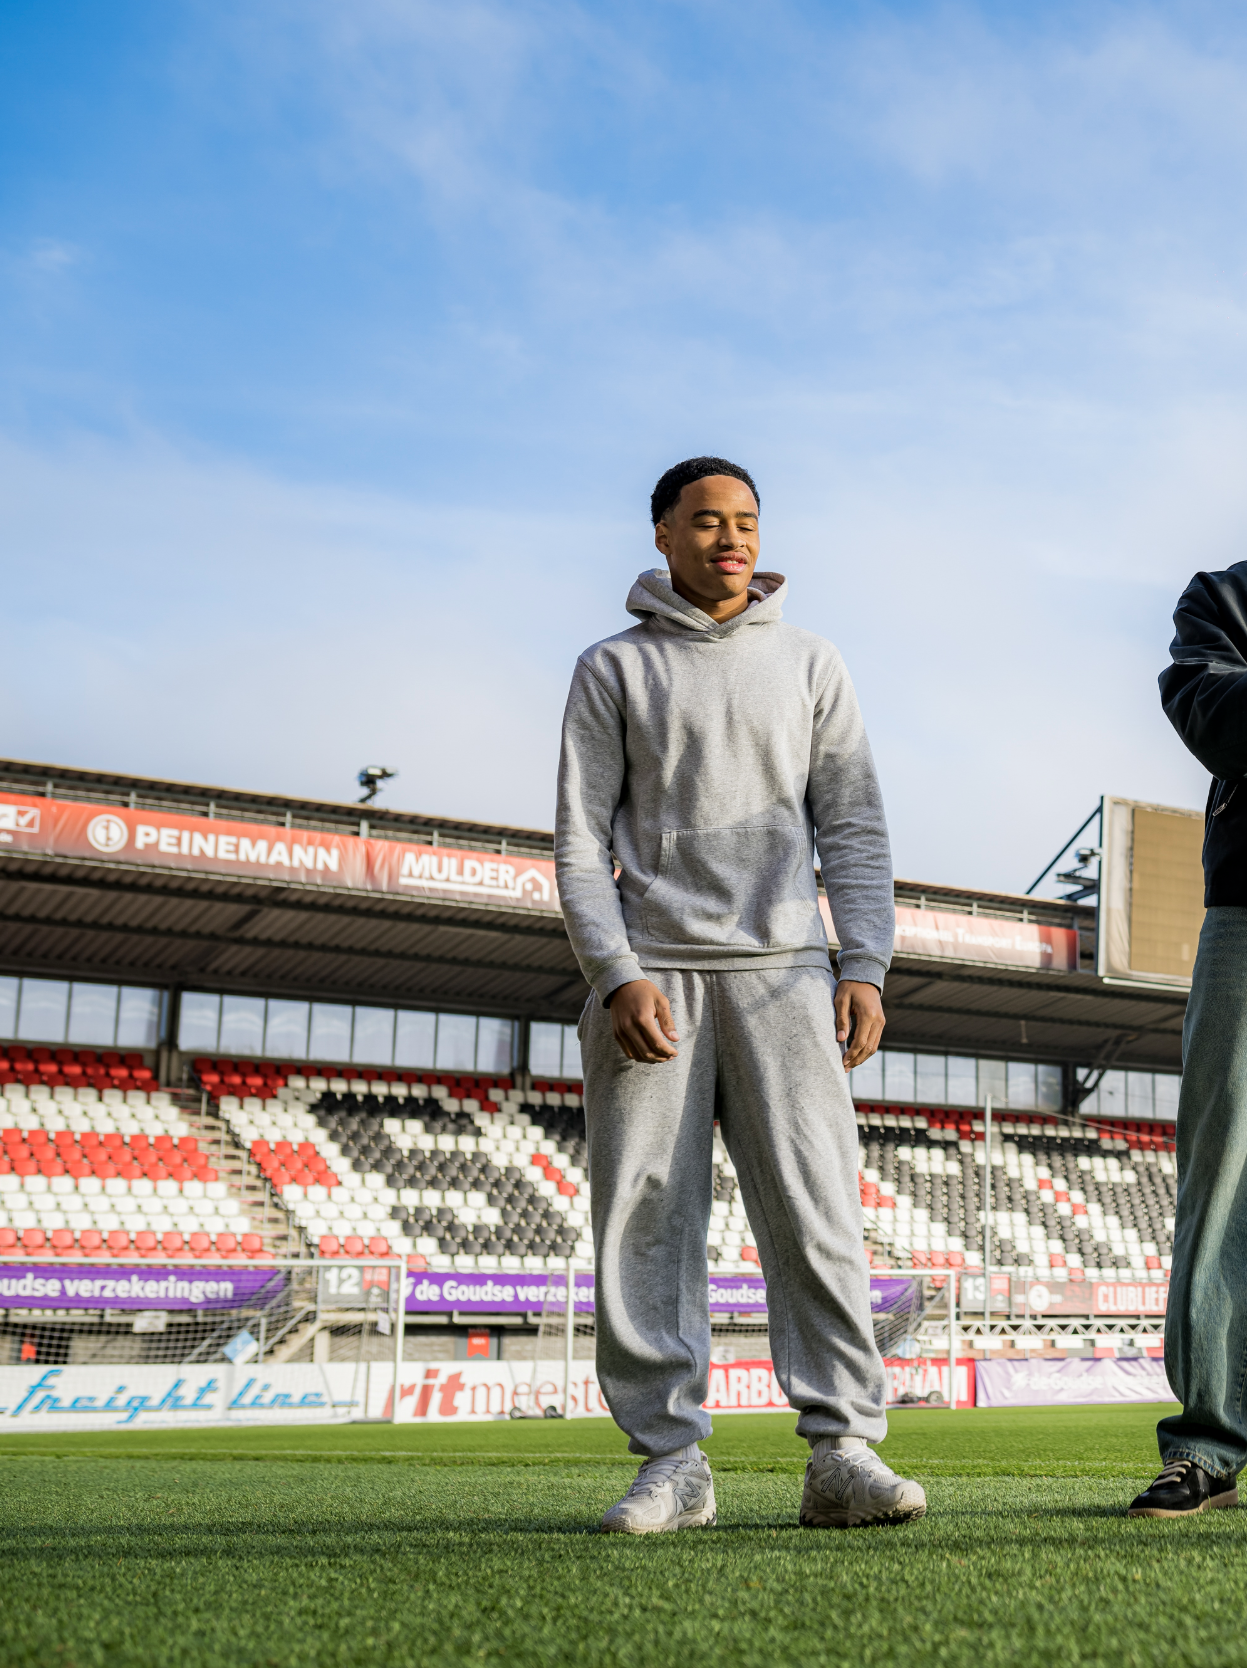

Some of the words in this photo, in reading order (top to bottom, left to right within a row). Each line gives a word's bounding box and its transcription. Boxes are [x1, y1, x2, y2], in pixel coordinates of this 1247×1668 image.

[135, 824, 339, 872] PEINEMANN
[401, 851, 516, 889] MULDER
[0, 1272, 61, 1297] udse
[63, 1273, 234, 1303] verzekeringen
[324, 1266, 361, 1295] 12
[414, 1279, 441, 1301] de
[442, 1279, 515, 1302] Goudse
[515, 1279, 595, 1302] verzeker
[1097, 1284, 1168, 1312] CLUBLIEF
